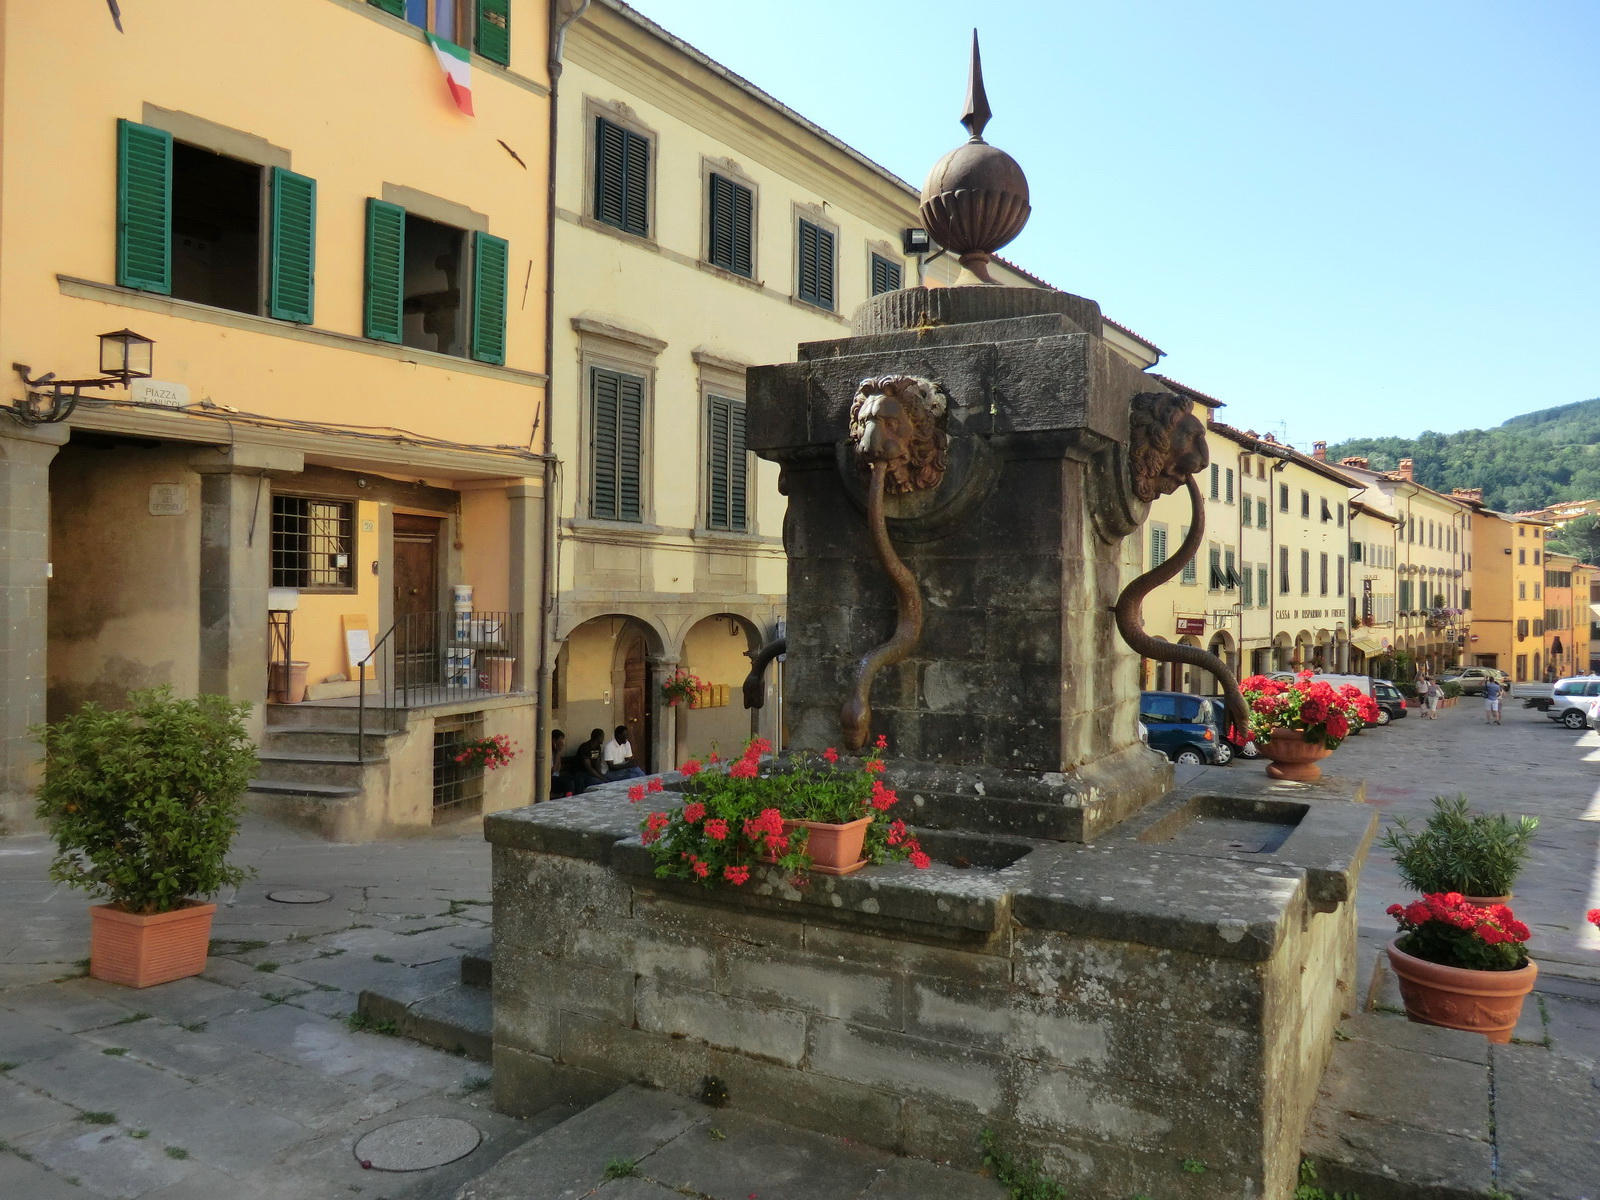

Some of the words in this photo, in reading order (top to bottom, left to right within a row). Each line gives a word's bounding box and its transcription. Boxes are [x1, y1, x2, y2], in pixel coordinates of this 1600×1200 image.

[145, 387, 177, 400] PIAZZA
[157, 487, 179, 496] VICOLO
[1275, 609, 1291, 620] CASSA
[1293, 609, 1299, 619] DI
